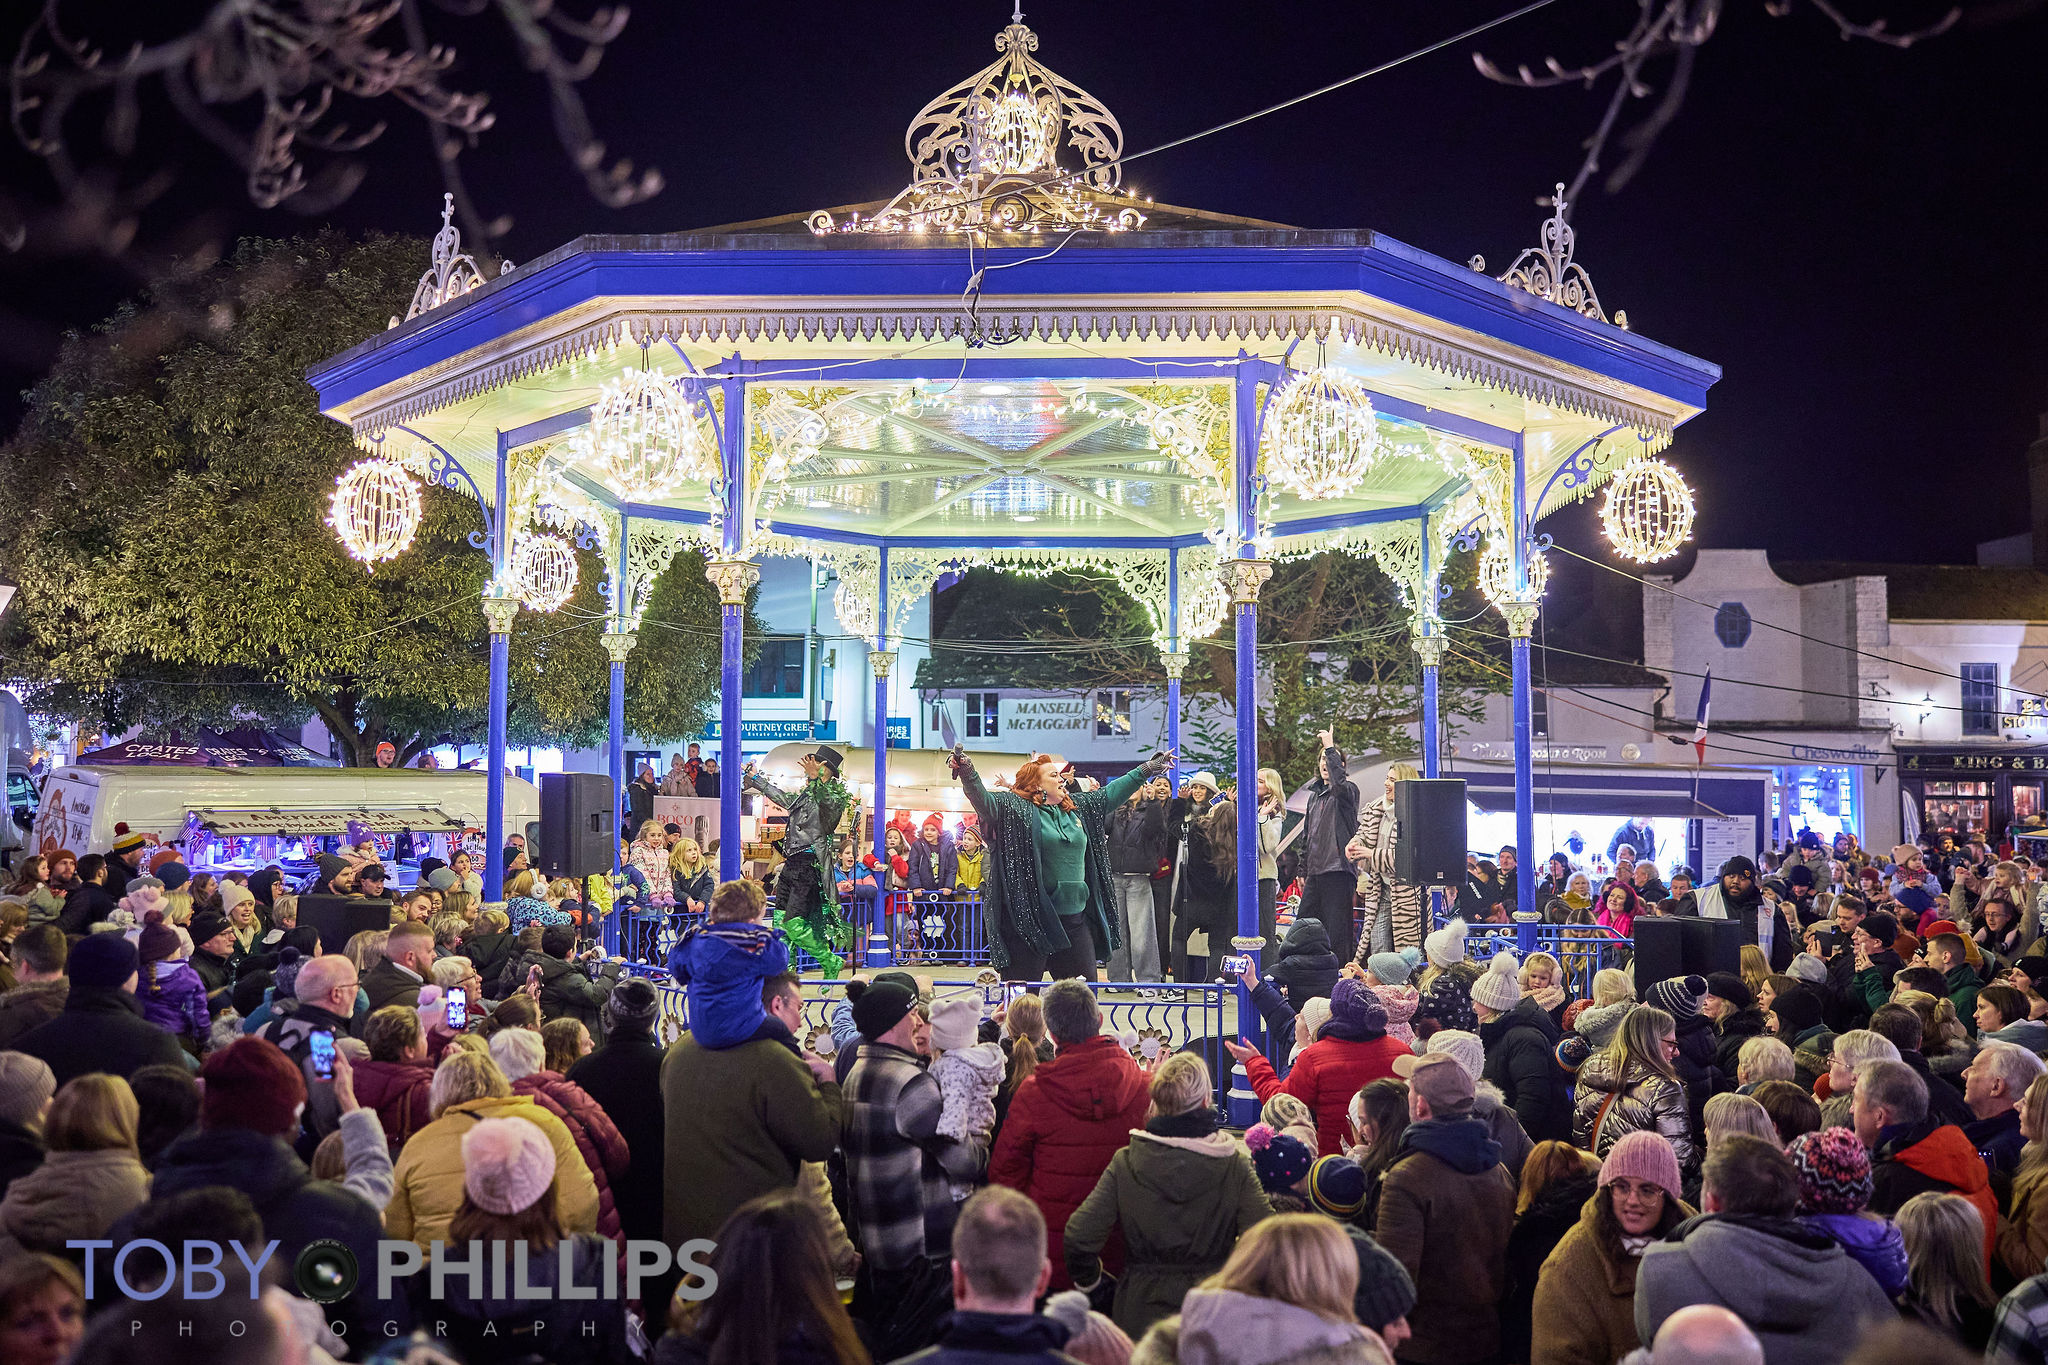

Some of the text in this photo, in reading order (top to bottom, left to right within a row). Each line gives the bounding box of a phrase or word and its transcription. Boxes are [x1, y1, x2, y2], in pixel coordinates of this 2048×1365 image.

[1016, 703, 1082, 714] MANSELL
[1007, 719, 1091, 730] McTAGGART
[2003, 715, 2044, 728] STOUT
[784, 723, 810, 732] GREE
[125, 744, 200, 755] CRATES
[125, 752, 182, 760] LOCAL
[1953, 756, 2048, 769] KING & B
[250, 811, 399, 821] American Style
[656, 814, 693, 825] BOCO
[228, 820, 339, 828] Homemade
